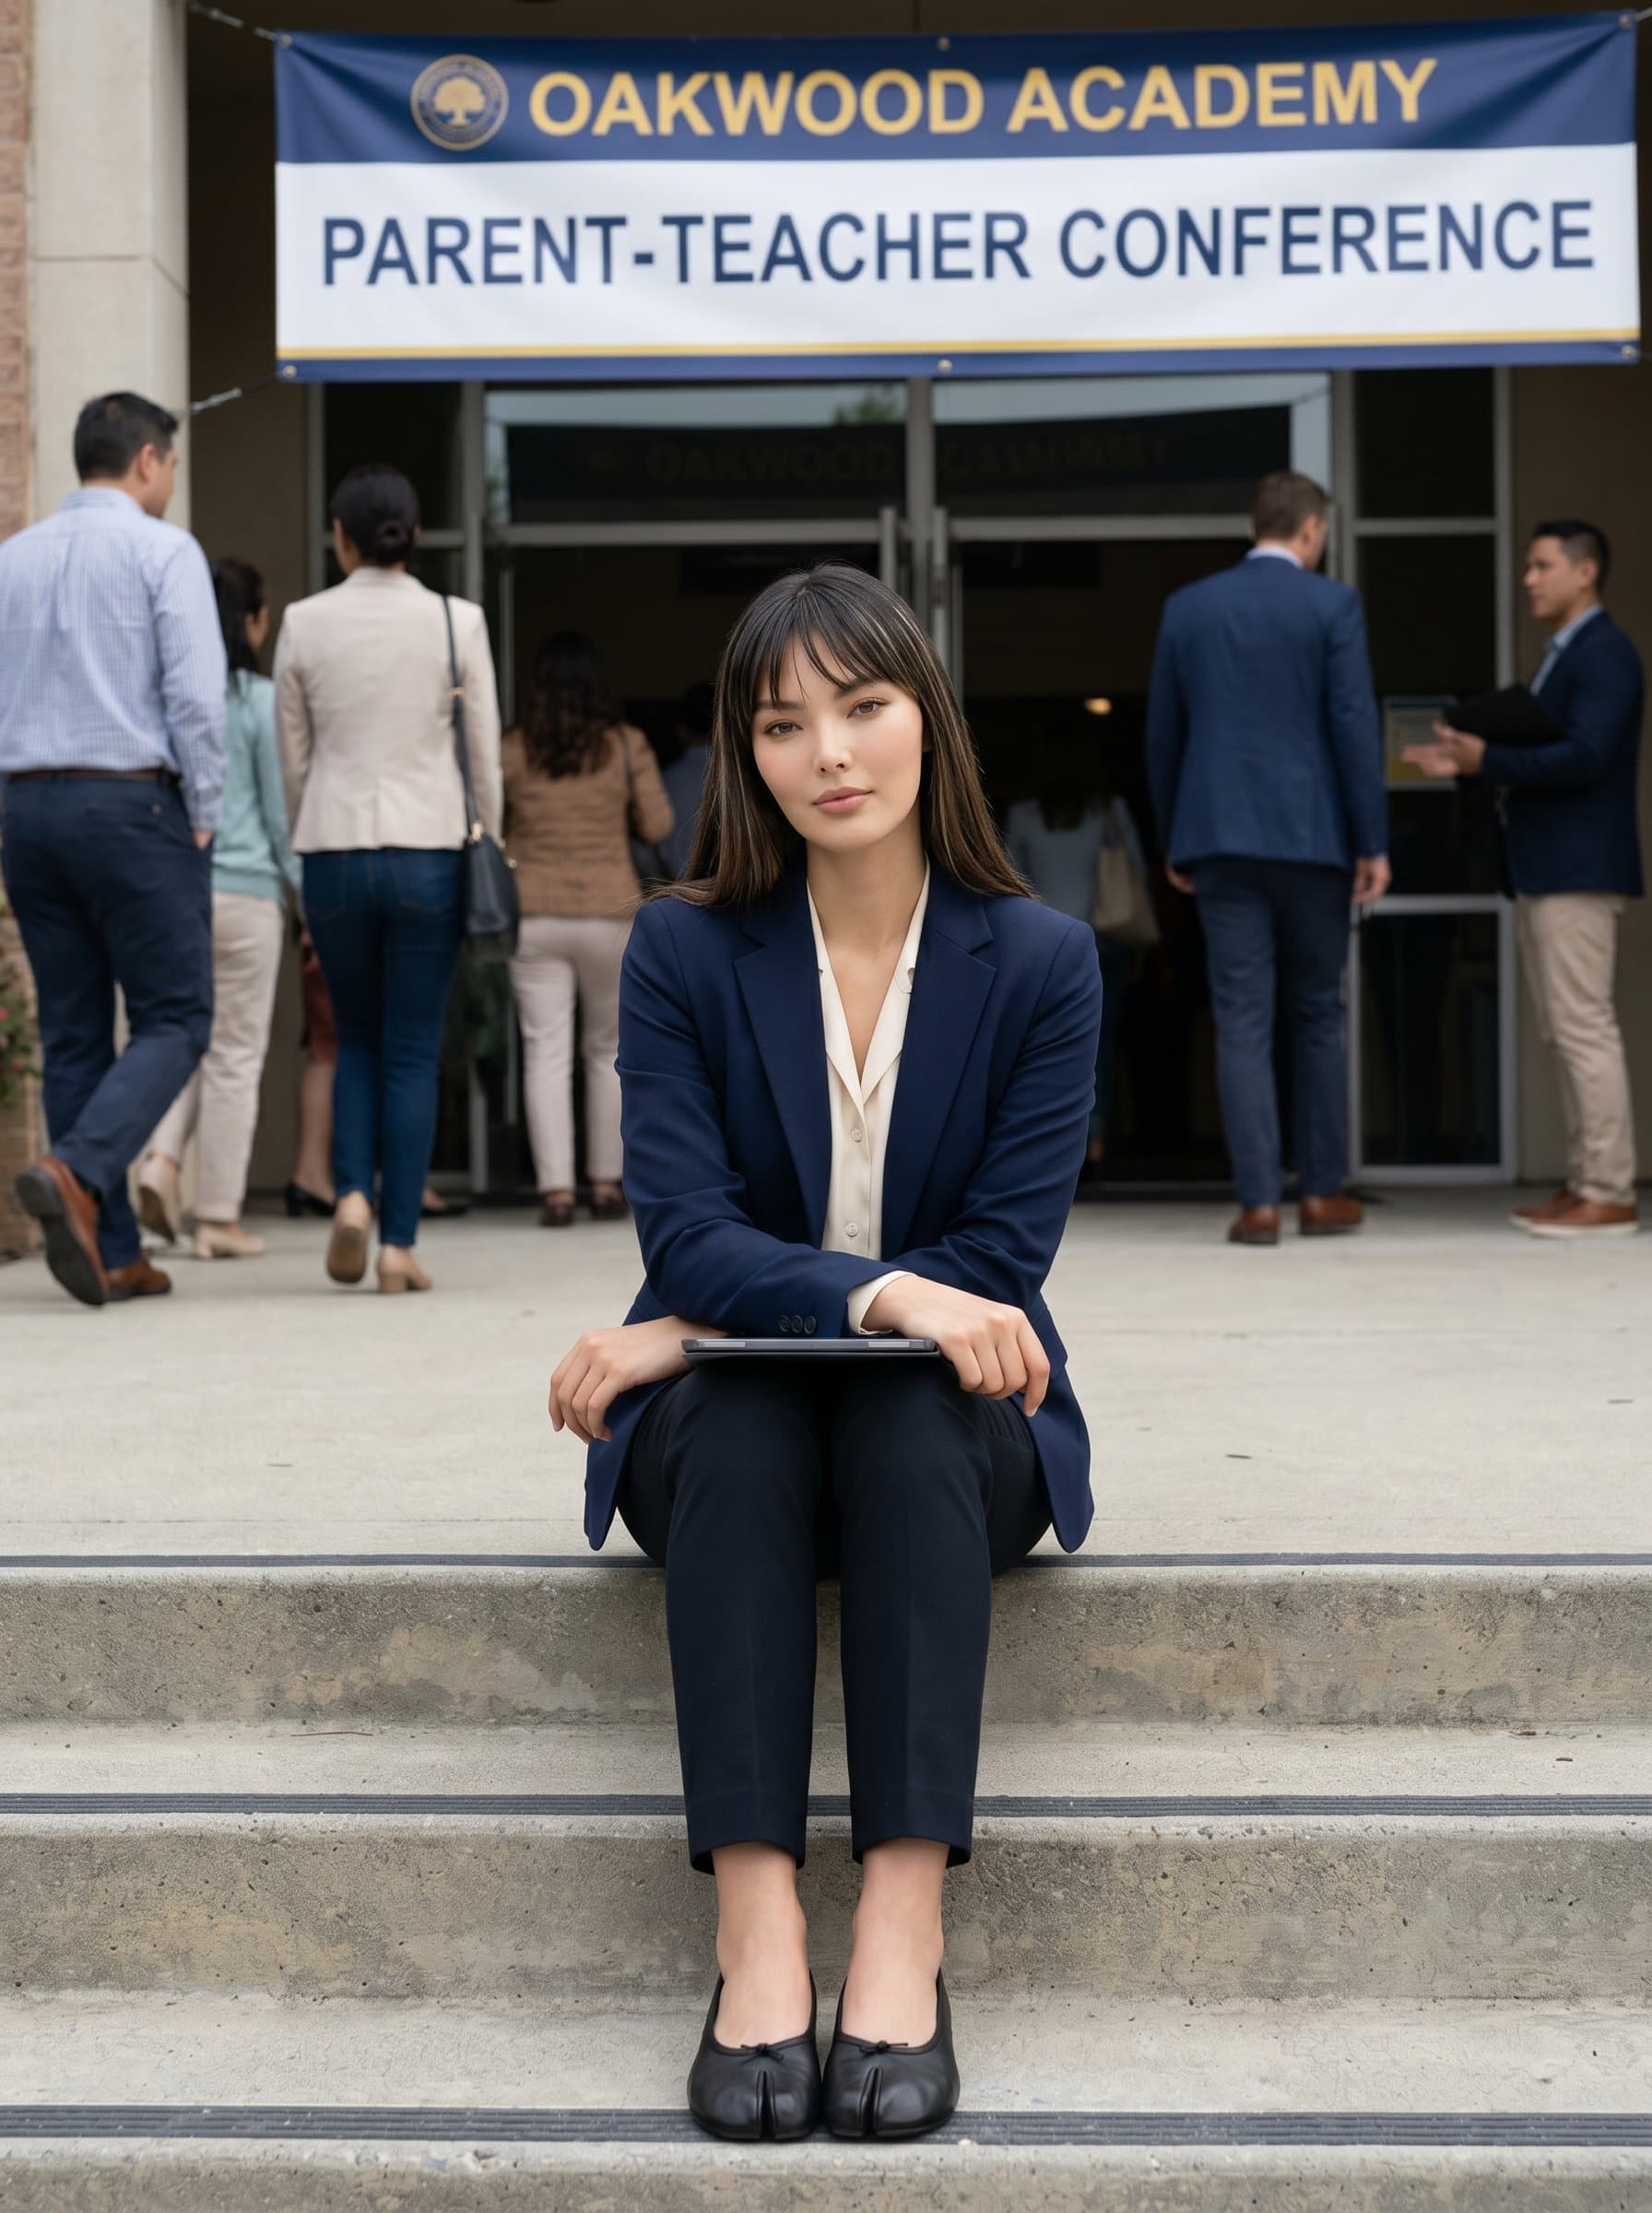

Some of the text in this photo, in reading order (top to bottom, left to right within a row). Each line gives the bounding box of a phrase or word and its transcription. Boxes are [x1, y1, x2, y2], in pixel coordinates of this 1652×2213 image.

[530, 69, 984, 137] OAKWOOD
[1007, 59, 1436, 132] ACADEMY
[324, 200, 1594, 286] PARENT-TEACHER CONFERENCE
